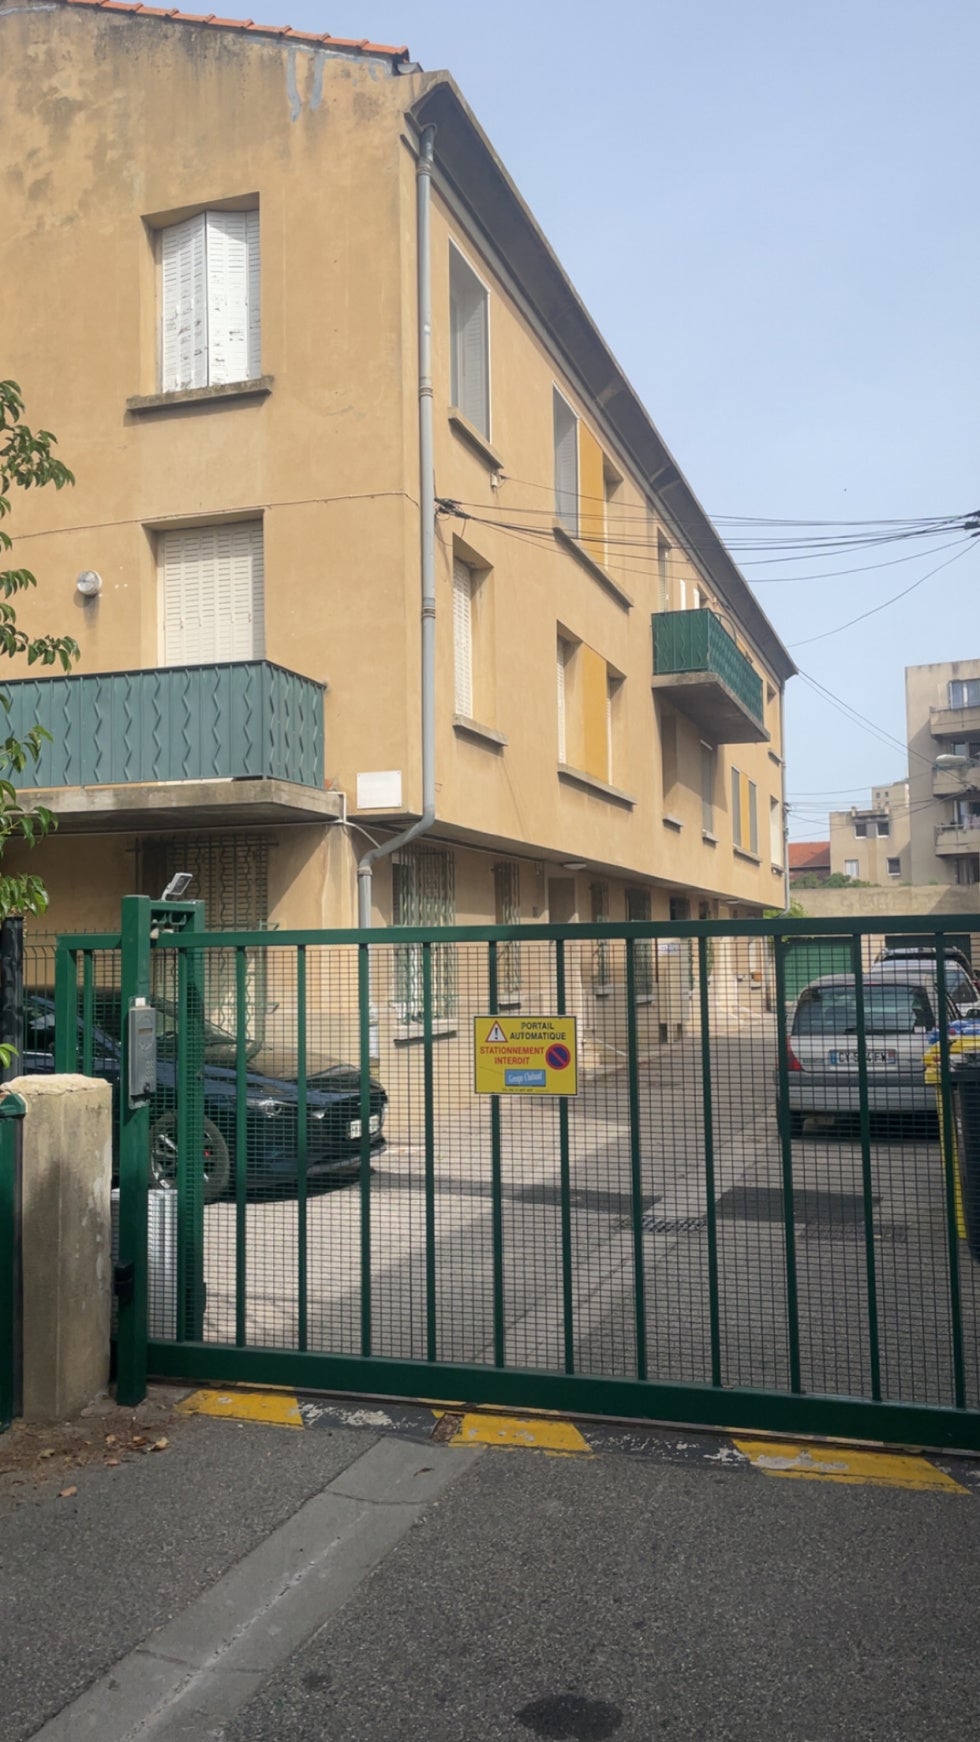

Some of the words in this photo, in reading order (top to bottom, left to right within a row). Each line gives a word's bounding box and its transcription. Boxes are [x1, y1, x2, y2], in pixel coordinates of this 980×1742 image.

[510, 1032, 566, 1040] AUTOMATIQUE
[480, 1046, 544, 1054] STATIONNEMENT
[494, 1057, 530, 1065] INTERDIT
